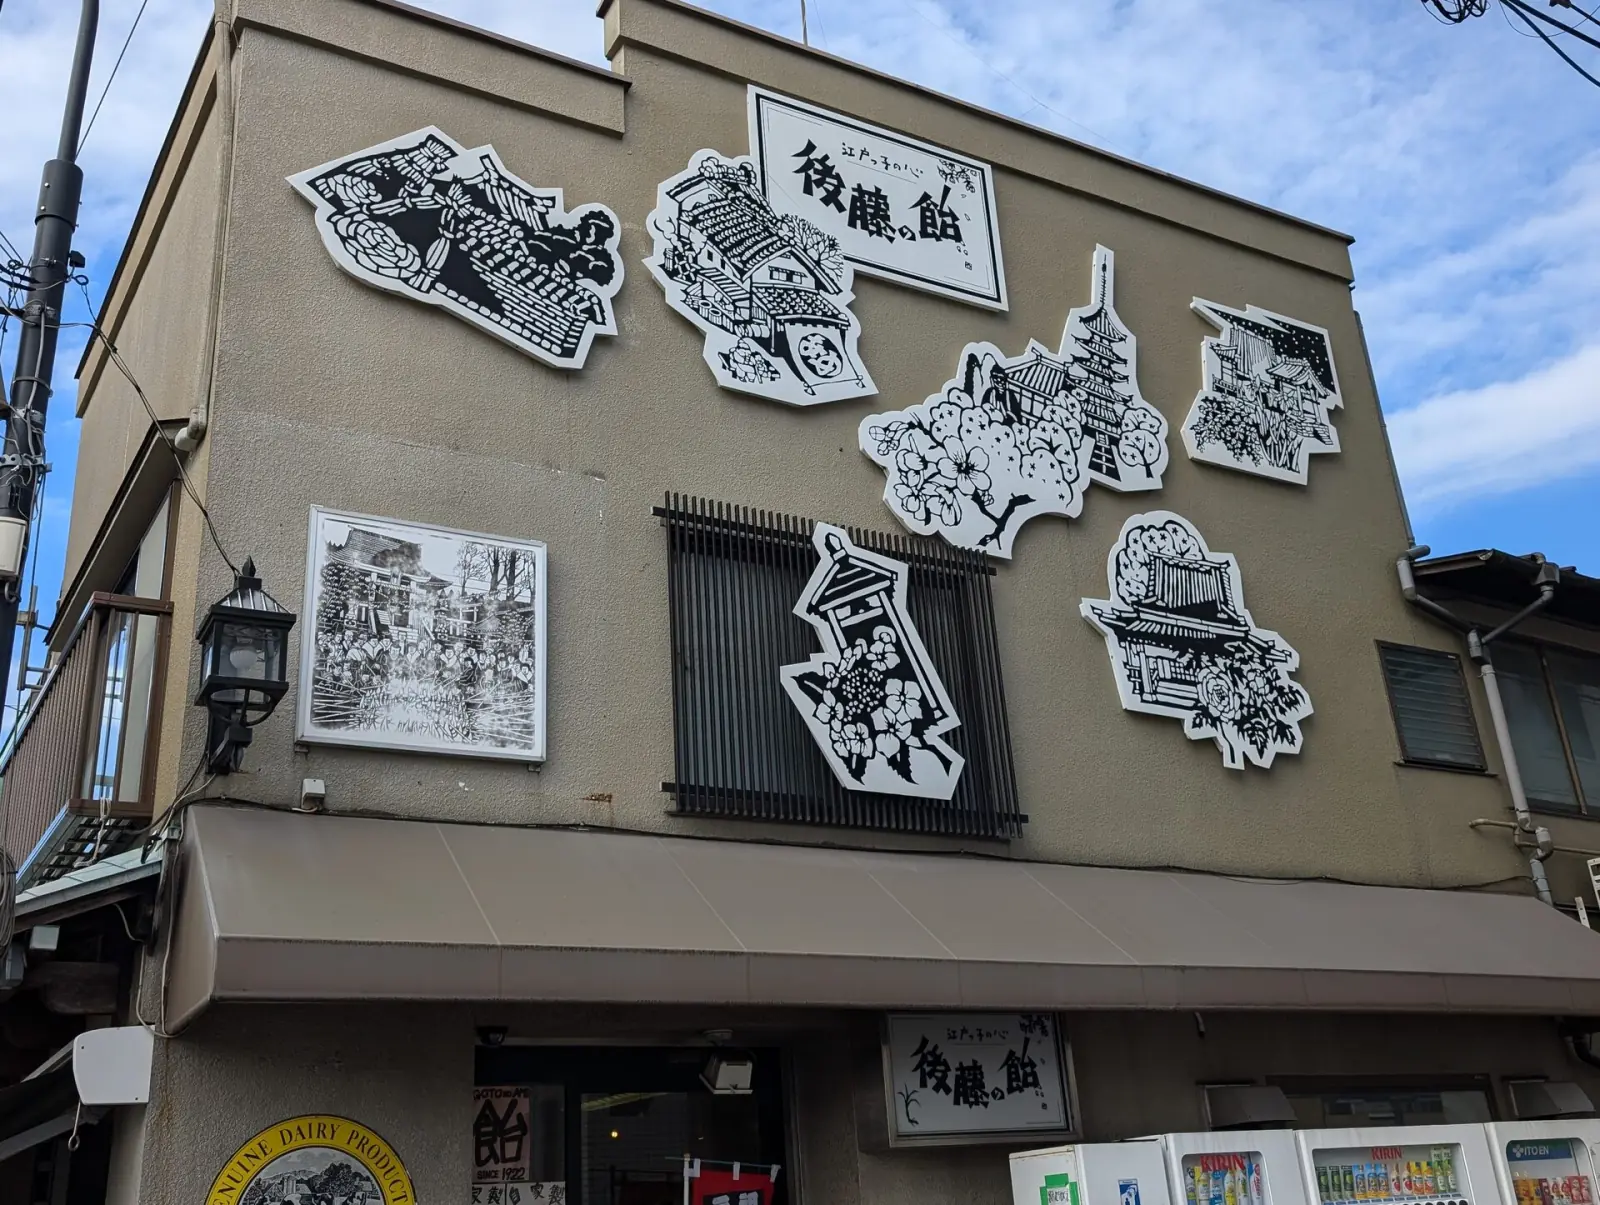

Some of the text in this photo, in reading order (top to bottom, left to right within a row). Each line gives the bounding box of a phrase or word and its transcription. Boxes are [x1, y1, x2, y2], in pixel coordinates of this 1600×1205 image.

[841, 141, 925, 179] 江戸っ子の心
[791, 138, 964, 244] 後藤の飴
[946, 1027, 1009, 1042] 江戸っ子の心
[909, 1034, 1041, 1109] 後藤の飴
[279, 1122, 341, 1147] DAIRY
[473, 1099, 527, 1167] 飴
[1200, 1151, 1246, 1172] KIRIN
[1371, 1145, 1403, 1160] KIRIN
[477, 1166, 525, 1180] SINCE 1922
